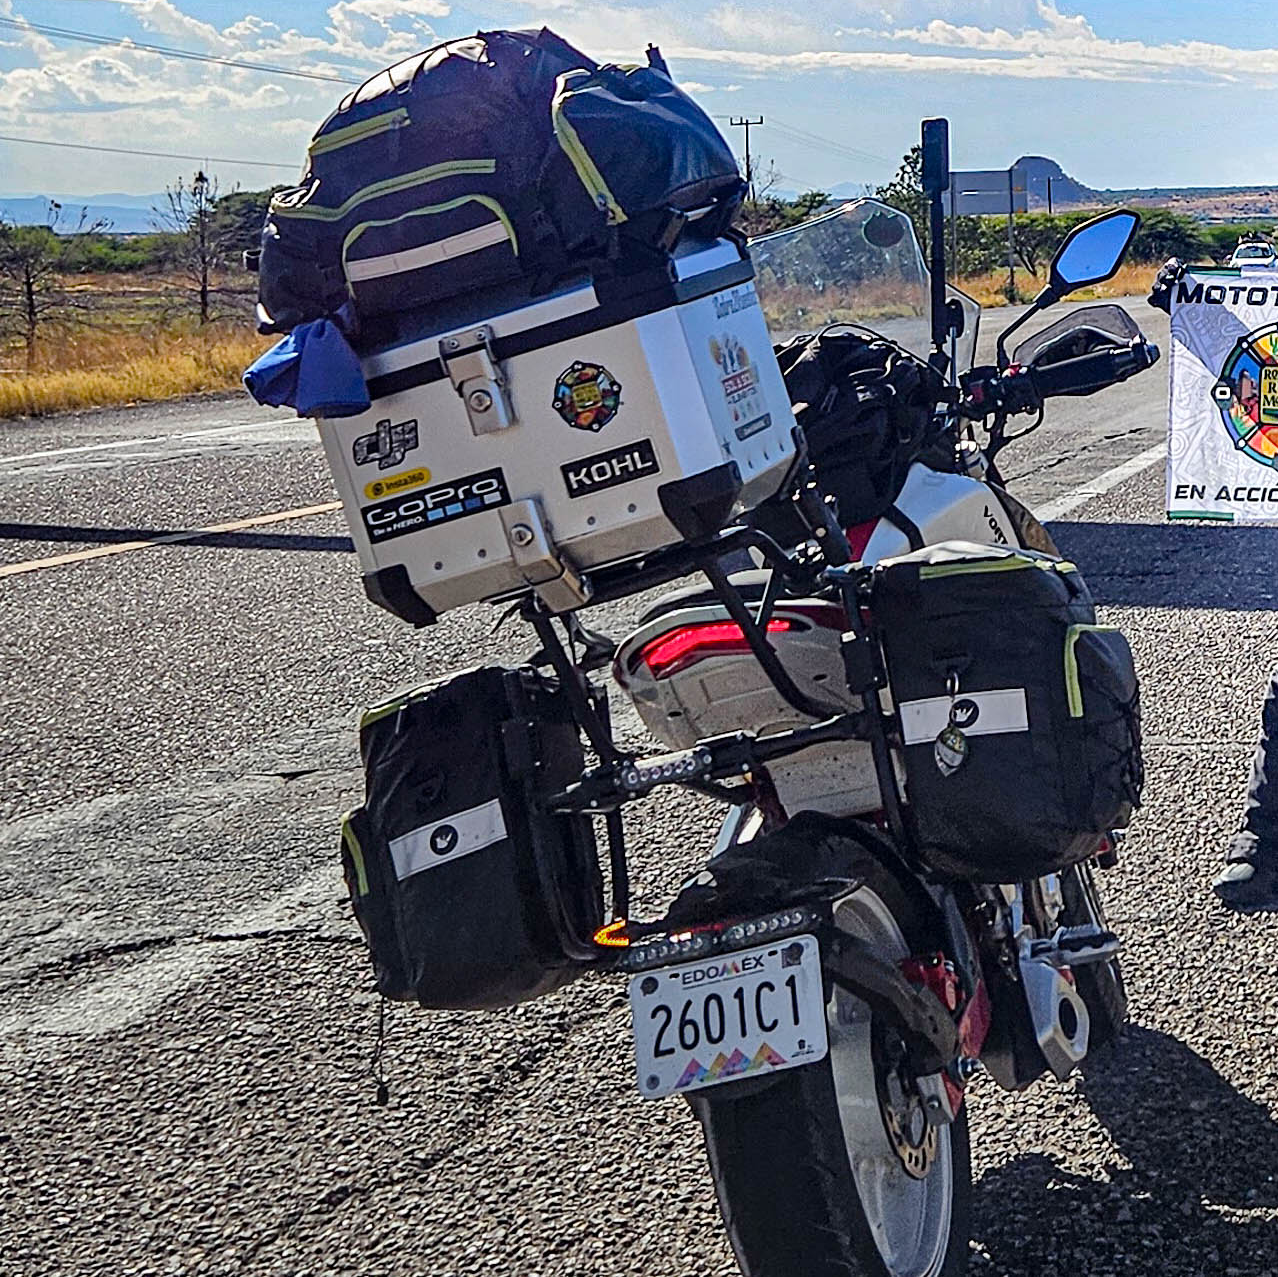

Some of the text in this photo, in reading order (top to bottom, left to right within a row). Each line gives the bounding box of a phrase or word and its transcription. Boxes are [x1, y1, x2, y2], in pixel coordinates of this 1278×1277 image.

[567, 451, 654, 491] KOHL
[1174, 485, 1206, 500] EN
[366, 478, 499, 527] GoPro
[650, 974, 799, 1059] 2601C1
